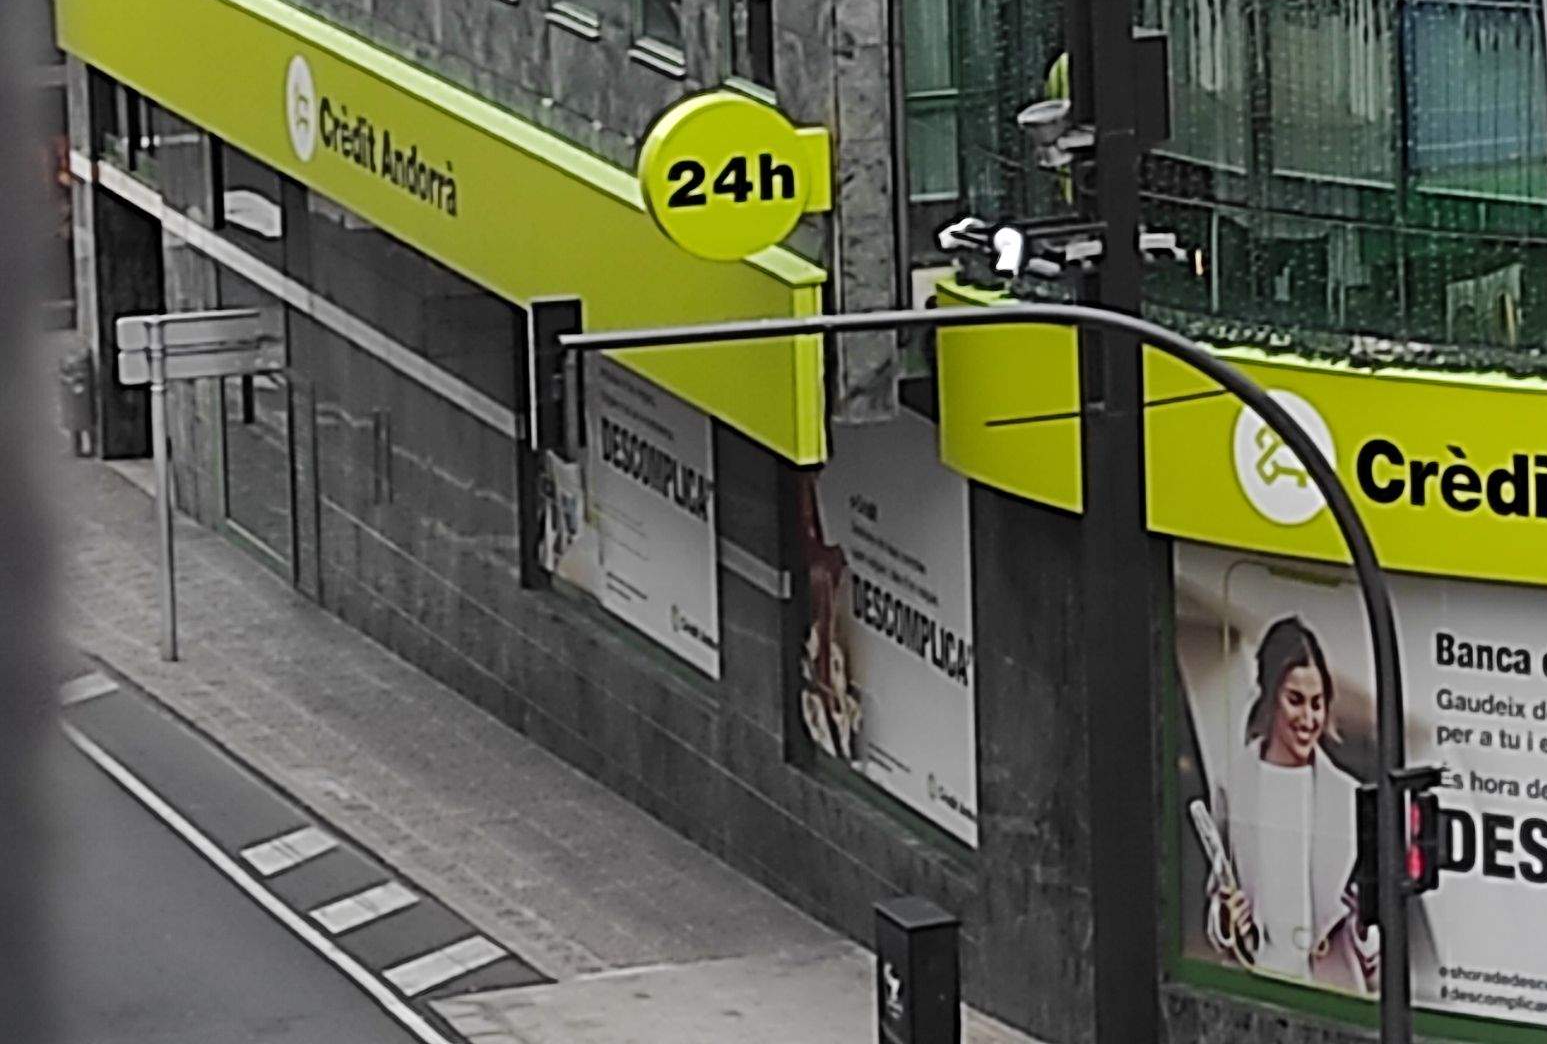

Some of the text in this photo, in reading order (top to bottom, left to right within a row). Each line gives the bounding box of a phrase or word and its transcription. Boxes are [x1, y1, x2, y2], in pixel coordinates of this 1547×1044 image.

[319, 96, 458, 217] Crèdit Andorrà
[667, 152, 795, 207] 24h
[1436, 632, 1532, 675] Banca
[1436, 689, 1526, 719] Gaudeix
[1437, 725, 1474, 746] per
[1480, 730, 1493, 747] a
[1500, 730, 1521, 751] tu
[1527, 731, 1534, 752] i
[1470, 771, 1520, 797] hora
